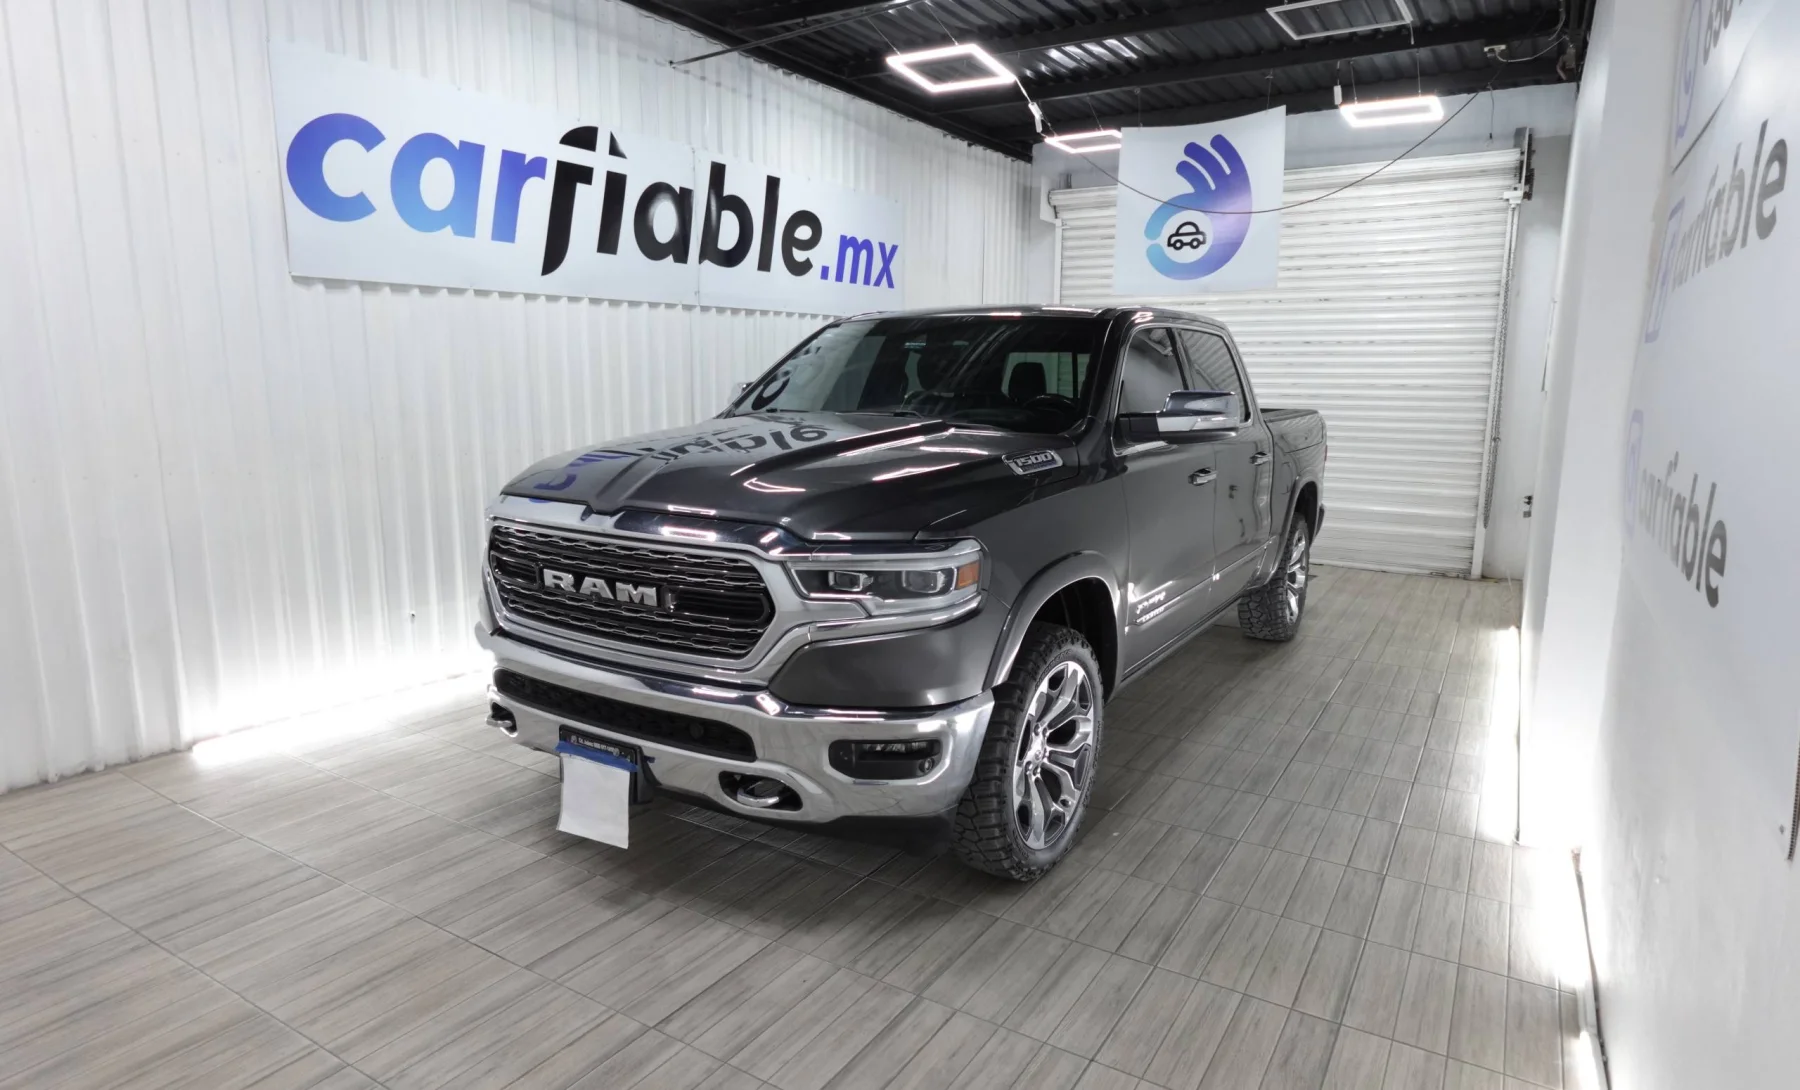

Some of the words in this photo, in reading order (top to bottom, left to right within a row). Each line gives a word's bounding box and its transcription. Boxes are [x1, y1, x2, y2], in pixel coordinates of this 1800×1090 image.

[286, 112, 899, 290] carfiable.mx
[1013, 452, 1053, 467] 1500
[543, 568, 658, 607] RAM
